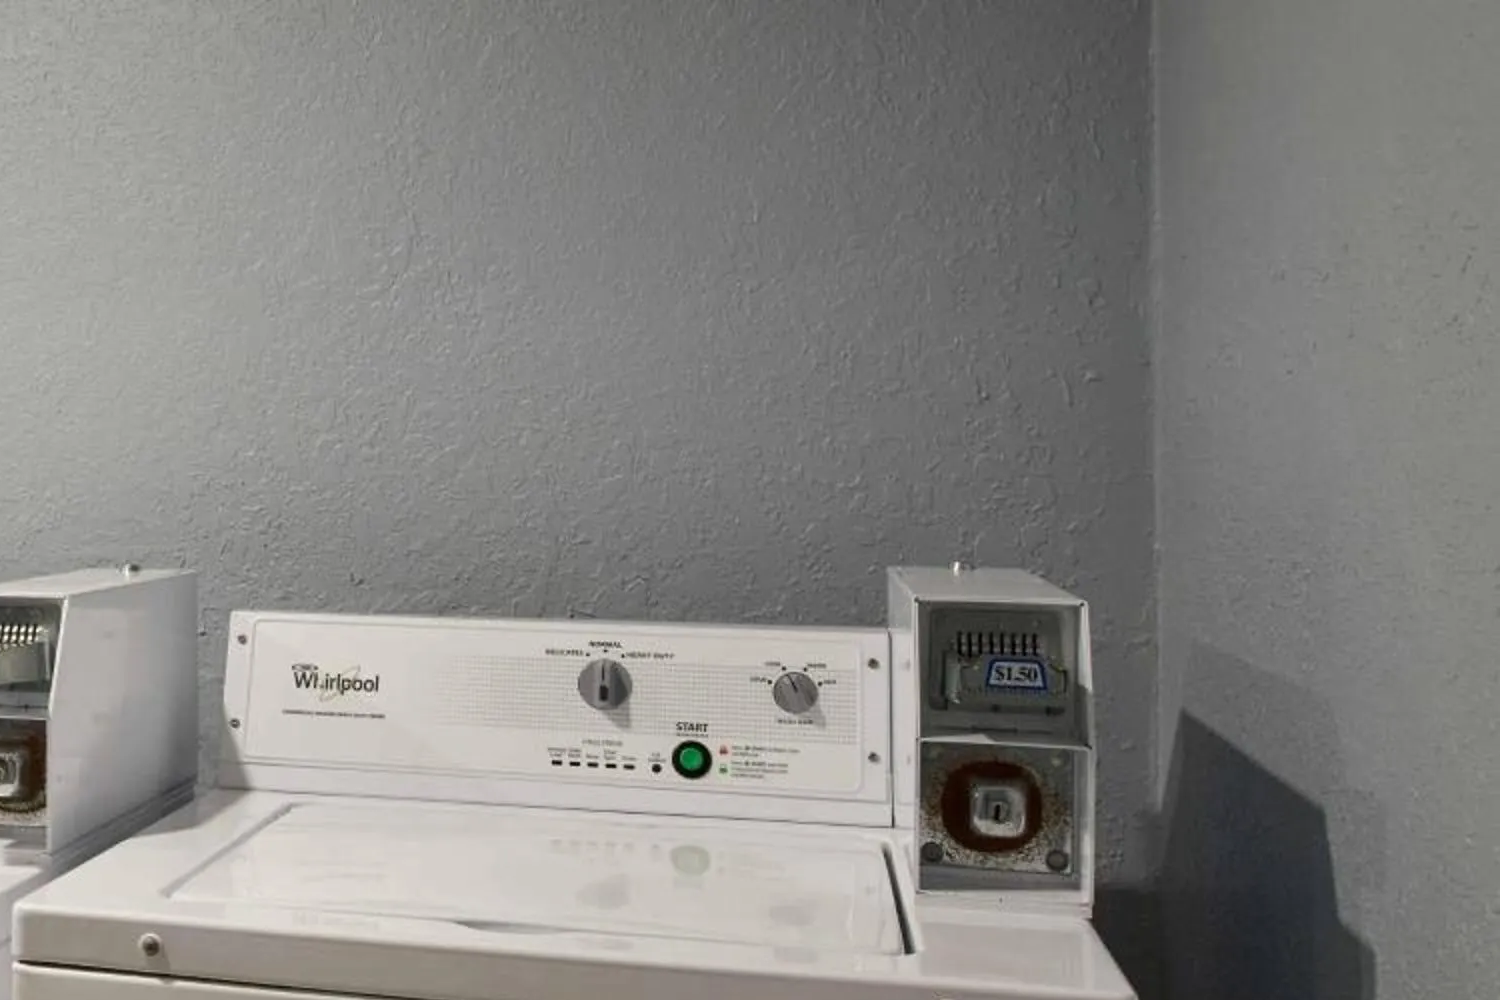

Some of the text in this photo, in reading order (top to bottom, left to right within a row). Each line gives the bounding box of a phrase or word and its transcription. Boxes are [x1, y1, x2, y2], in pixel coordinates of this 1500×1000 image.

[994, 665, 1039, 682] $1.50
[293, 671, 380, 695] Whirlpool
[675, 720, 708, 733] START
